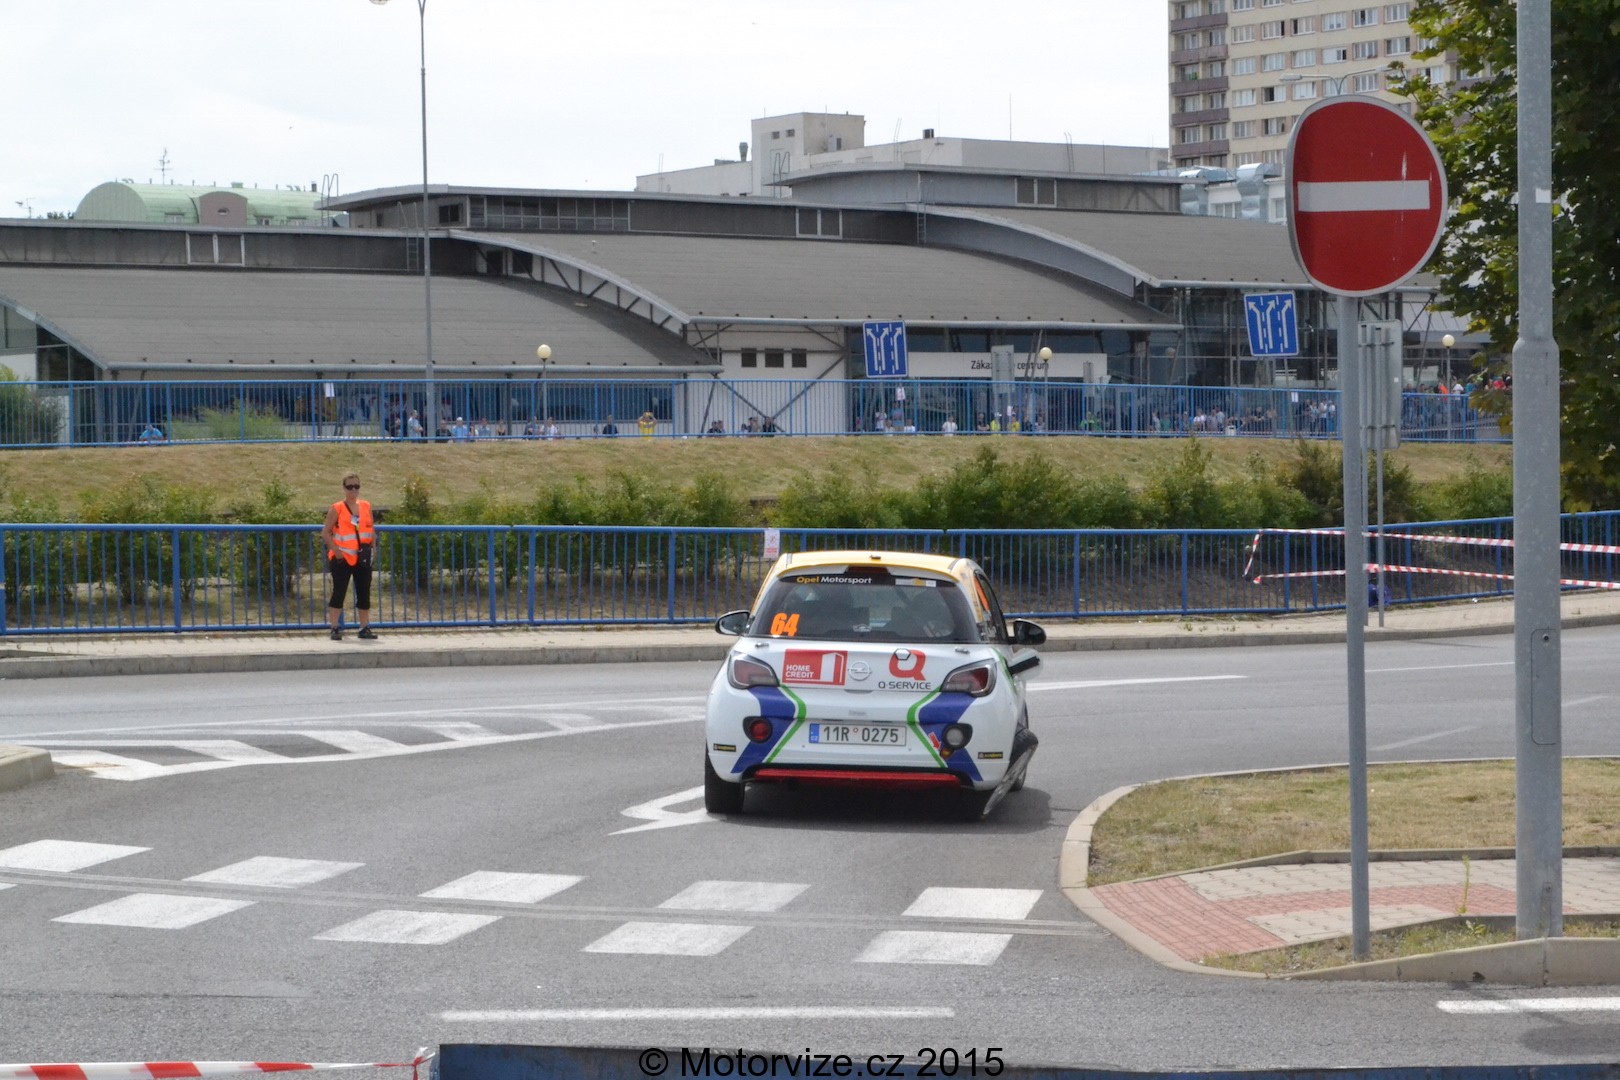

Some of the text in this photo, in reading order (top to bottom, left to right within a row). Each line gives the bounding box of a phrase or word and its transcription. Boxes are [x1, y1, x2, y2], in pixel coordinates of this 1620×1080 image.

[796, 576, 872, 585] Opel Motorsport
[770, 613, 800, 637] 64
[786, 664, 811, 672] HOME
[785, 670, 814, 679] CREDIT
[888, 681, 932, 690] SERVICE
[823, 726, 899, 743] 11R 0275
